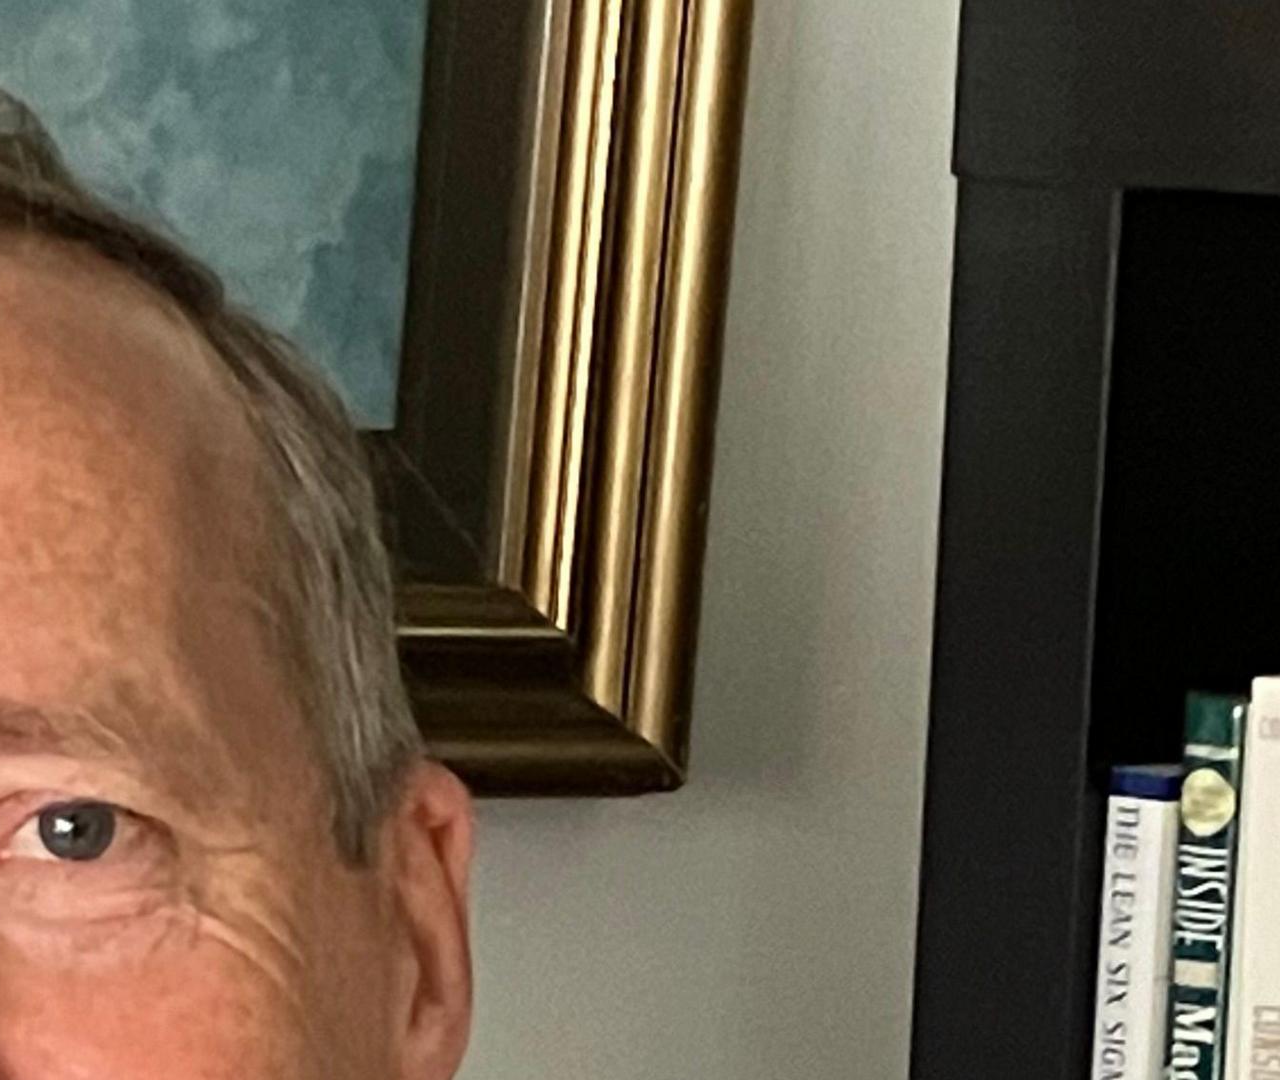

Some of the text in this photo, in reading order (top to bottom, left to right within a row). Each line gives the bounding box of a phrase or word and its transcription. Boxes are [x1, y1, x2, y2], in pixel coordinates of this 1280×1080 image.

[1111, 804, 1141, 860] THE
[1108, 870, 1138, 949] LEAN
[1173, 843, 1229, 951] INSIDE
[1106, 960, 1131, 1006] SIX
